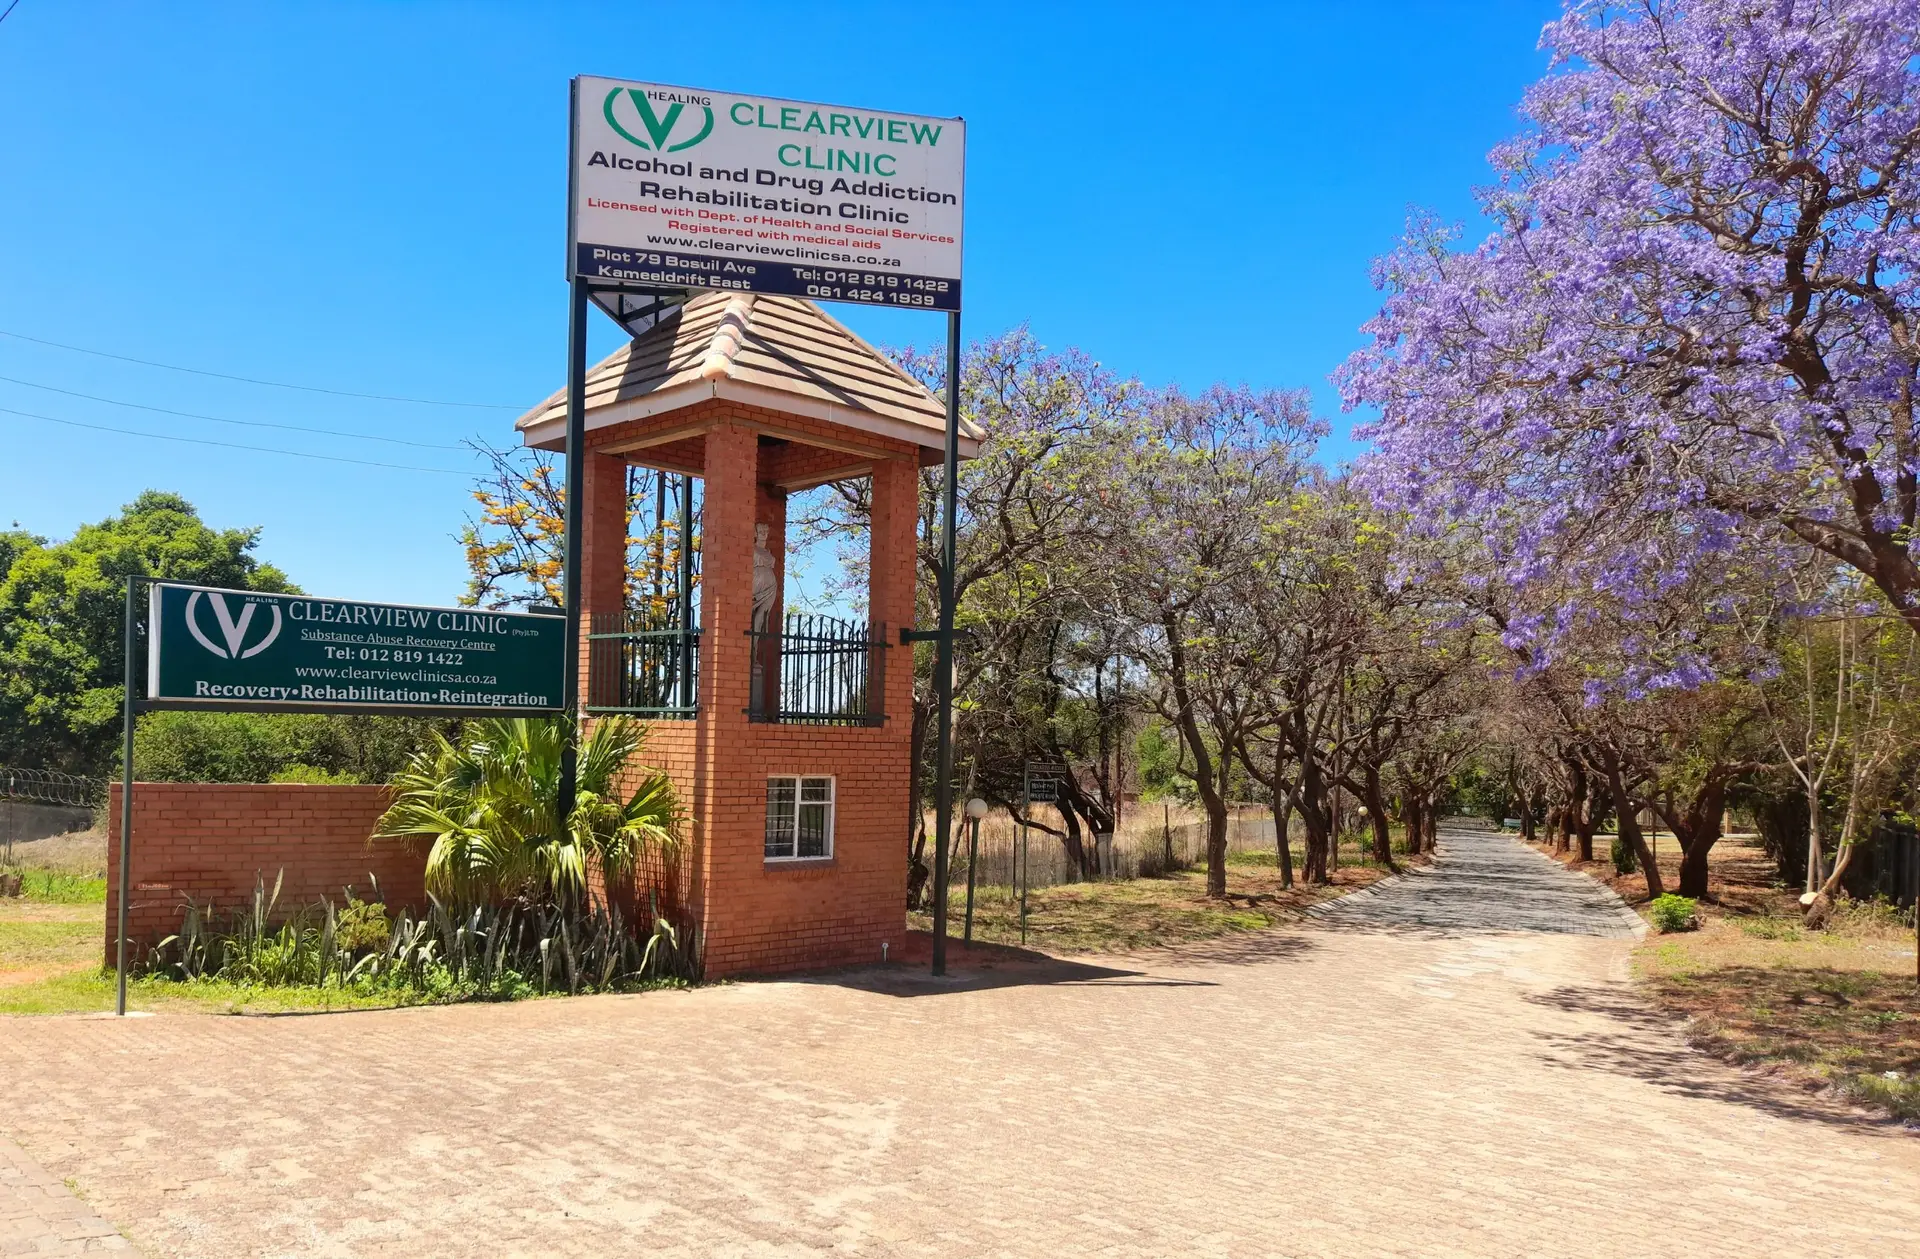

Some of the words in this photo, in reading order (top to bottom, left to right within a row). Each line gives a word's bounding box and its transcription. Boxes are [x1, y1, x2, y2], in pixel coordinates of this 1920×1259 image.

[647, 90, 711, 106] HEALING
[729, 102, 943, 147] CLEARVIEW
[777, 143, 897, 177] CLINIC
[587, 150, 693, 177] Alcohol
[699, 166, 749, 183] and
[755, 168, 824, 196] Drug
[830, 177, 957, 205] Addiction
[640, 180, 832, 217] Rehabilitation
[838, 202, 910, 224] Clinic
[587, 197, 657, 214] Licensed
[660, 206, 694, 217] with
[697, 209, 740, 223] Dept.
[743, 215, 759, 224] of
[762, 216, 812, 230] Health
[814, 222, 841, 232] and
[844, 223, 889, 237] Social
[891, 228, 955, 243] Services
[668, 219, 753, 237] Registered
[757, 229, 790, 241] with
[792, 233, 849, 247] medical
[851, 238, 882, 250] aids
[593, 248, 631, 263] Plot
[635, 252, 661, 265] 79
[665, 255, 720, 271] Bosuil
[723, 261, 757, 274] Ave
[646, 234, 901, 267] www.clearviewclinicsa.co.za
[598, 264, 706, 286] Kameeldrift
[709, 275, 751, 290] East
[792, 267, 821, 281] Tel:
[824, 270, 860, 284] 012
[863, 274, 899, 287] 819
[903, 277, 949, 292] 1422
[806, 284, 842, 298] 061
[847, 288, 885, 301] 424
[888, 291, 935, 306] 1939
[245, 596, 279, 604] HEALING
[288, 600, 432, 629] CLEARVIEW
[437, 612, 508, 635] CLINIC
[301, 628, 364, 642] Substance
[366, 632, 403, 645] Abuse
[406, 635, 458, 650] Recovery
[460, 638, 496, 651] Centre
[324, 645, 355, 660] Tel:
[359, 648, 389, 662] 012
[393, 650, 423, 663] 819
[427, 652, 463, 665] 1422
[295, 664, 497, 685] www.clearviewclinicsa.co.za
